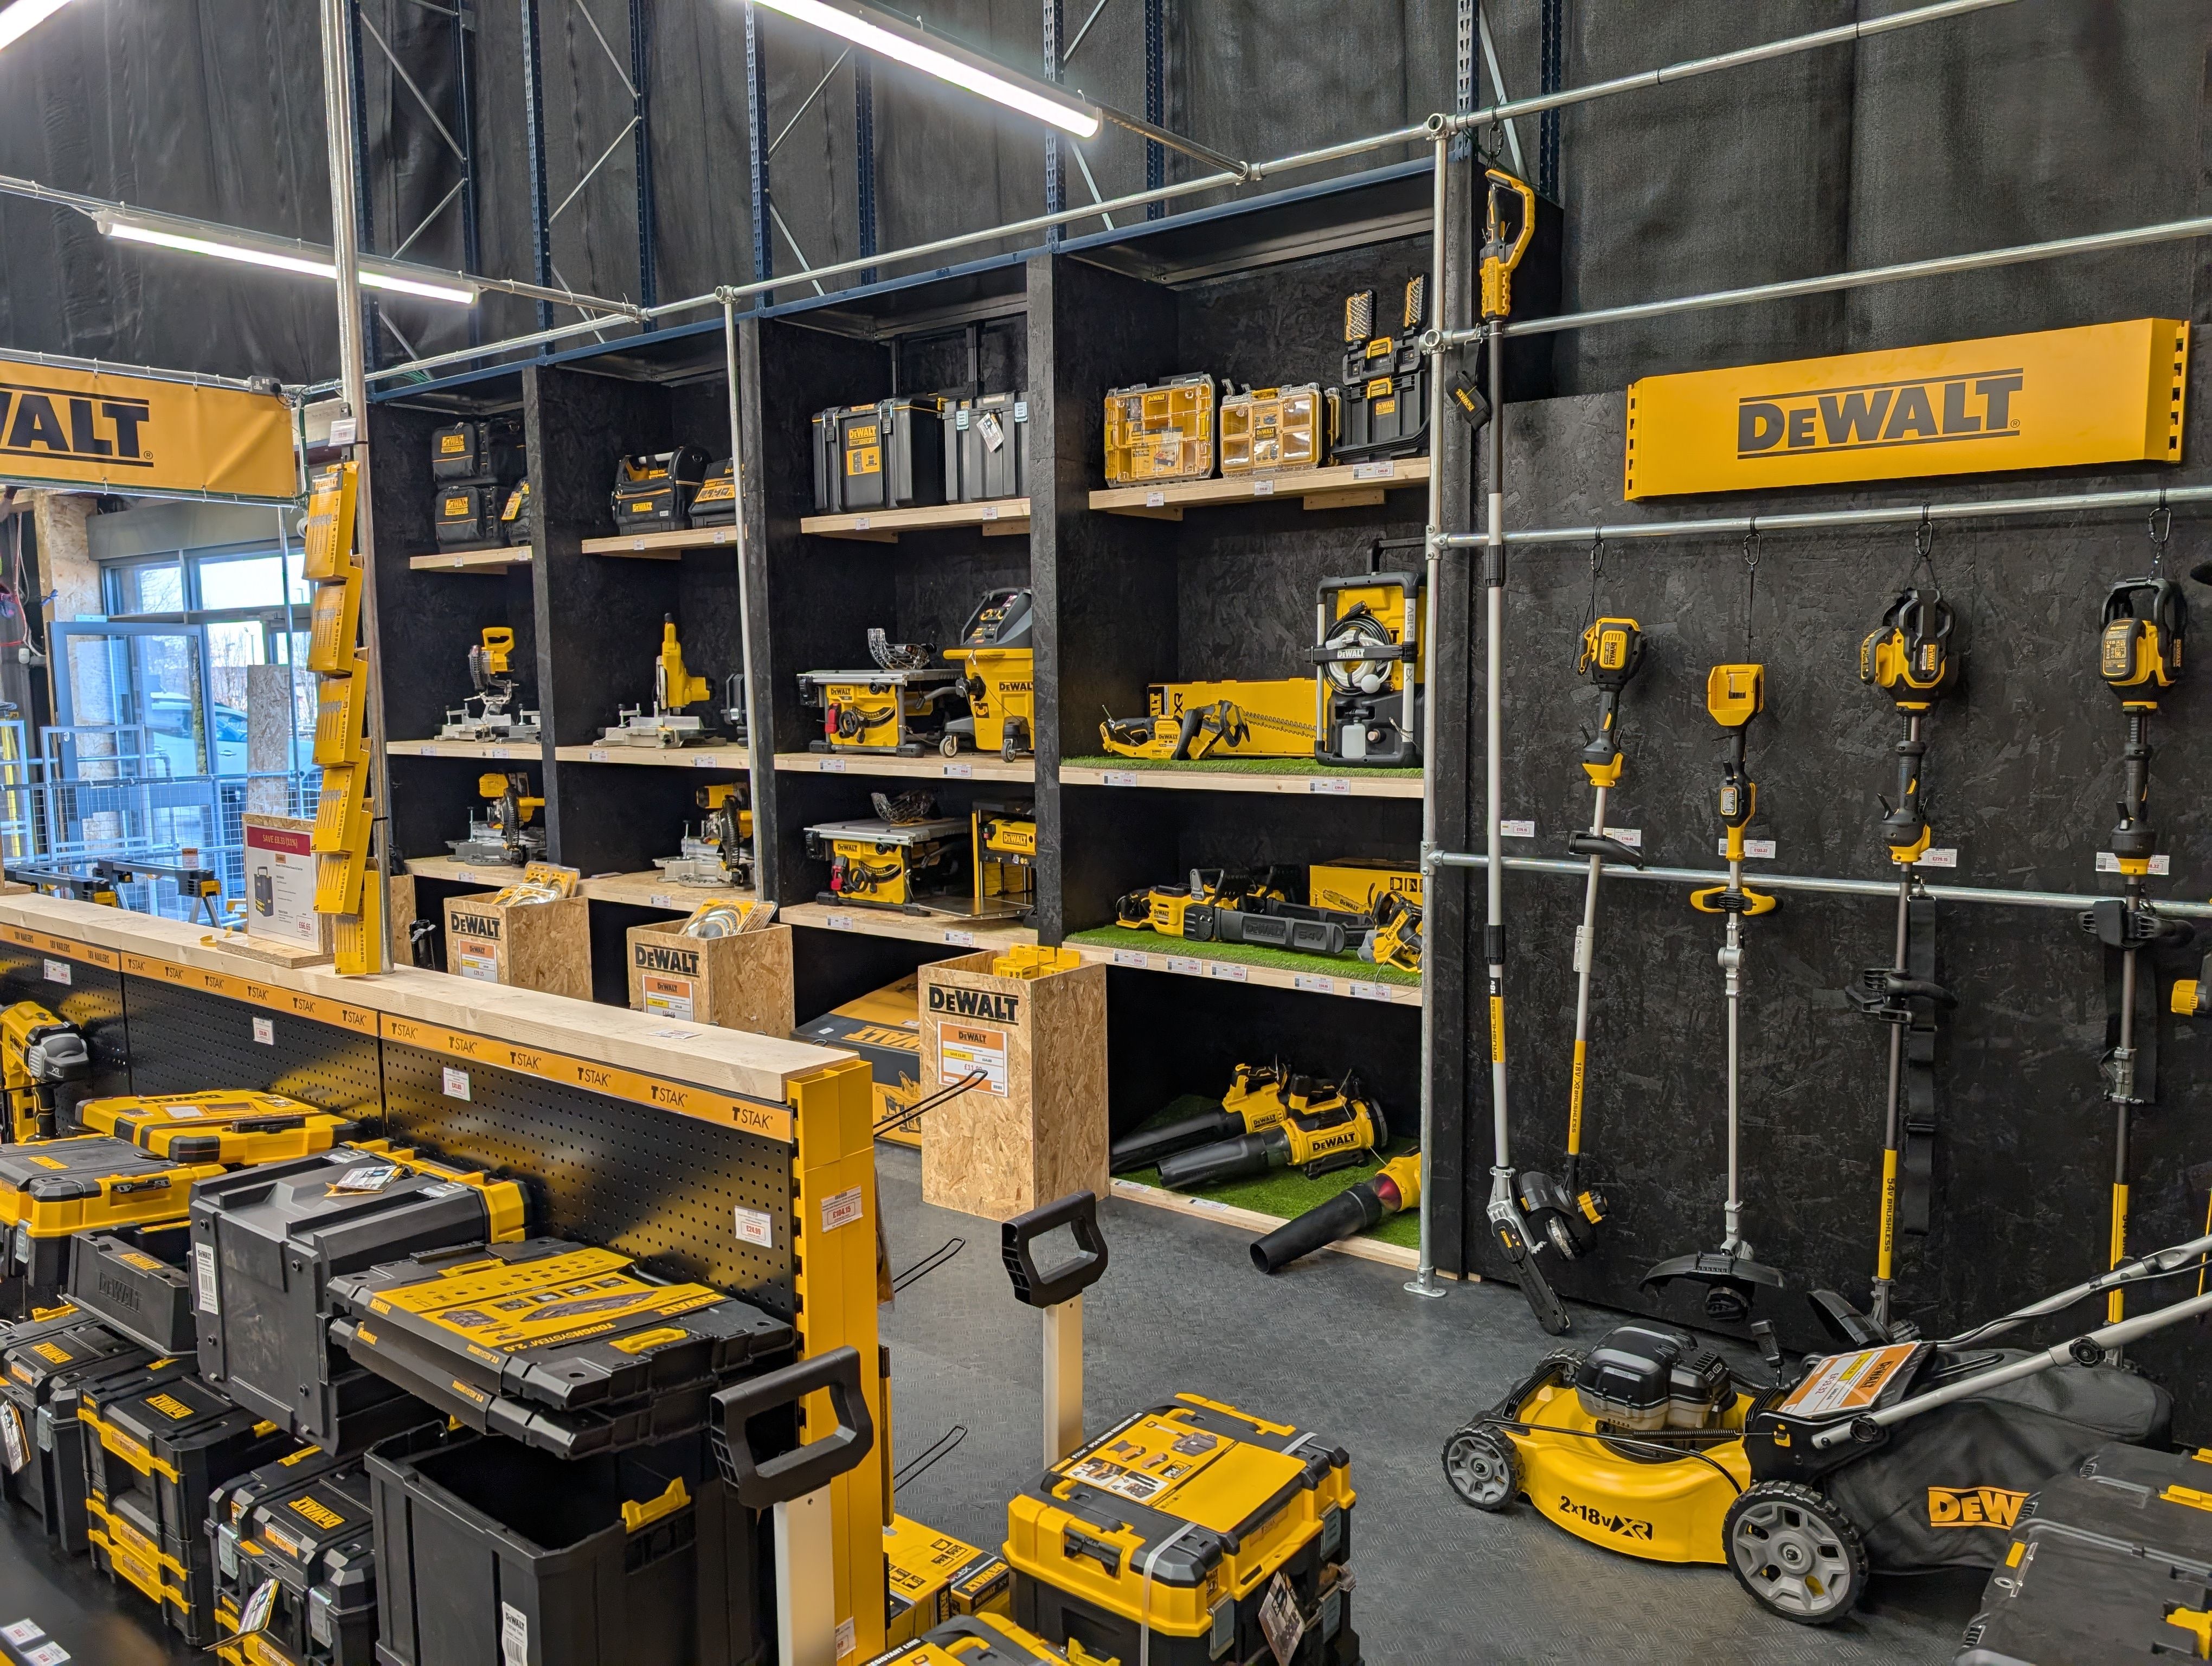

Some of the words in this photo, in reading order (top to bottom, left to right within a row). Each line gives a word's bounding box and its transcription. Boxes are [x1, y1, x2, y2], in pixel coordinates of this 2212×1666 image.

[1148, 394, 1165, 402] DEWALT
[1456, 389, 1475, 412] DEWALT
[1738, 375, 2023, 452] DEWALT
[849, 427, 876, 438] DEWALT
[1257, 428, 1275, 436] DEWALT
[442, 435, 464, 446] DEWALT
[446, 498, 468, 509] DEWALT
[633, 502, 652, 511] DEWALT
[1338, 649, 1365, 658] DEWALT
[1406, 668, 1413, 682] XR
[1000, 683, 1033, 691] DEWAL
[1174, 692, 1183, 715] XR
[262, 835, 274, 843] SAVE
[274, 837, 285, 845] £8.33
[1004, 833, 1026, 844] DEWALT
[838, 843, 858, 852] DEWALT
[1340, 899, 1359, 911] DEWALT
[451, 913, 500, 938] DEWALT
[1246, 924, 1284, 937] DEWALT
[1387, 918, 1401, 937] DEWALT
[21, 933, 34, 943] NAILERS
[56, 942, 70, 953] NAILERS
[470, 945, 485, 954] DEWALT
[94, 952, 110, 964] NAILERS
[635, 945, 699, 974] DEWALT
[658, 982, 677, 993] DEWALT
[929, 986, 1019, 1021] DEWALT
[959, 1031, 987, 1043] DEWALT
[52, 1066, 60, 1075] XR
[1253, 1114, 1276, 1126] DEWALT
[1313, 1132, 1355, 1151] DEWALT
[833, 1206, 851, 1219] £104.15
[746, 1225, 761, 1235] £24.99
[1884, 1198, 1893, 1252] BRUSHLESS
[198, 1250, 211, 1260] DEWALT
[119, 1253, 164, 1271] DEWALT
[370, 1298, 390, 1315] DEWALT
[653, 1293, 726, 1316] DEWALT
[357, 1327, 378, 1345] DEWALT
[532, 1322, 616, 1347] TOUGHSYSTEM
[31, 1342, 74, 1364] DEWALT
[466, 1344, 491, 1361] TOUGHSYSTEM
[503, 1342, 528, 1353] 2.0
[1860, 1360, 1895, 1389] DEWALT
[452, 1380, 477, 1398] TOUGHSYSTEM
[1815, 1372, 1840, 1395] £433.32
[145, 1393, 194, 1419] DEWALT
[288, 1495, 345, 1529] DEWALT
[1928, 1490, 2025, 1527] DEW
[1609, 1515, 1654, 1540] XR
[962, 1561, 1009, 1593] DEWALT
[506, 1612, 525, 1631] DEWALT
[903, 1638, 921, 1650] LINE
